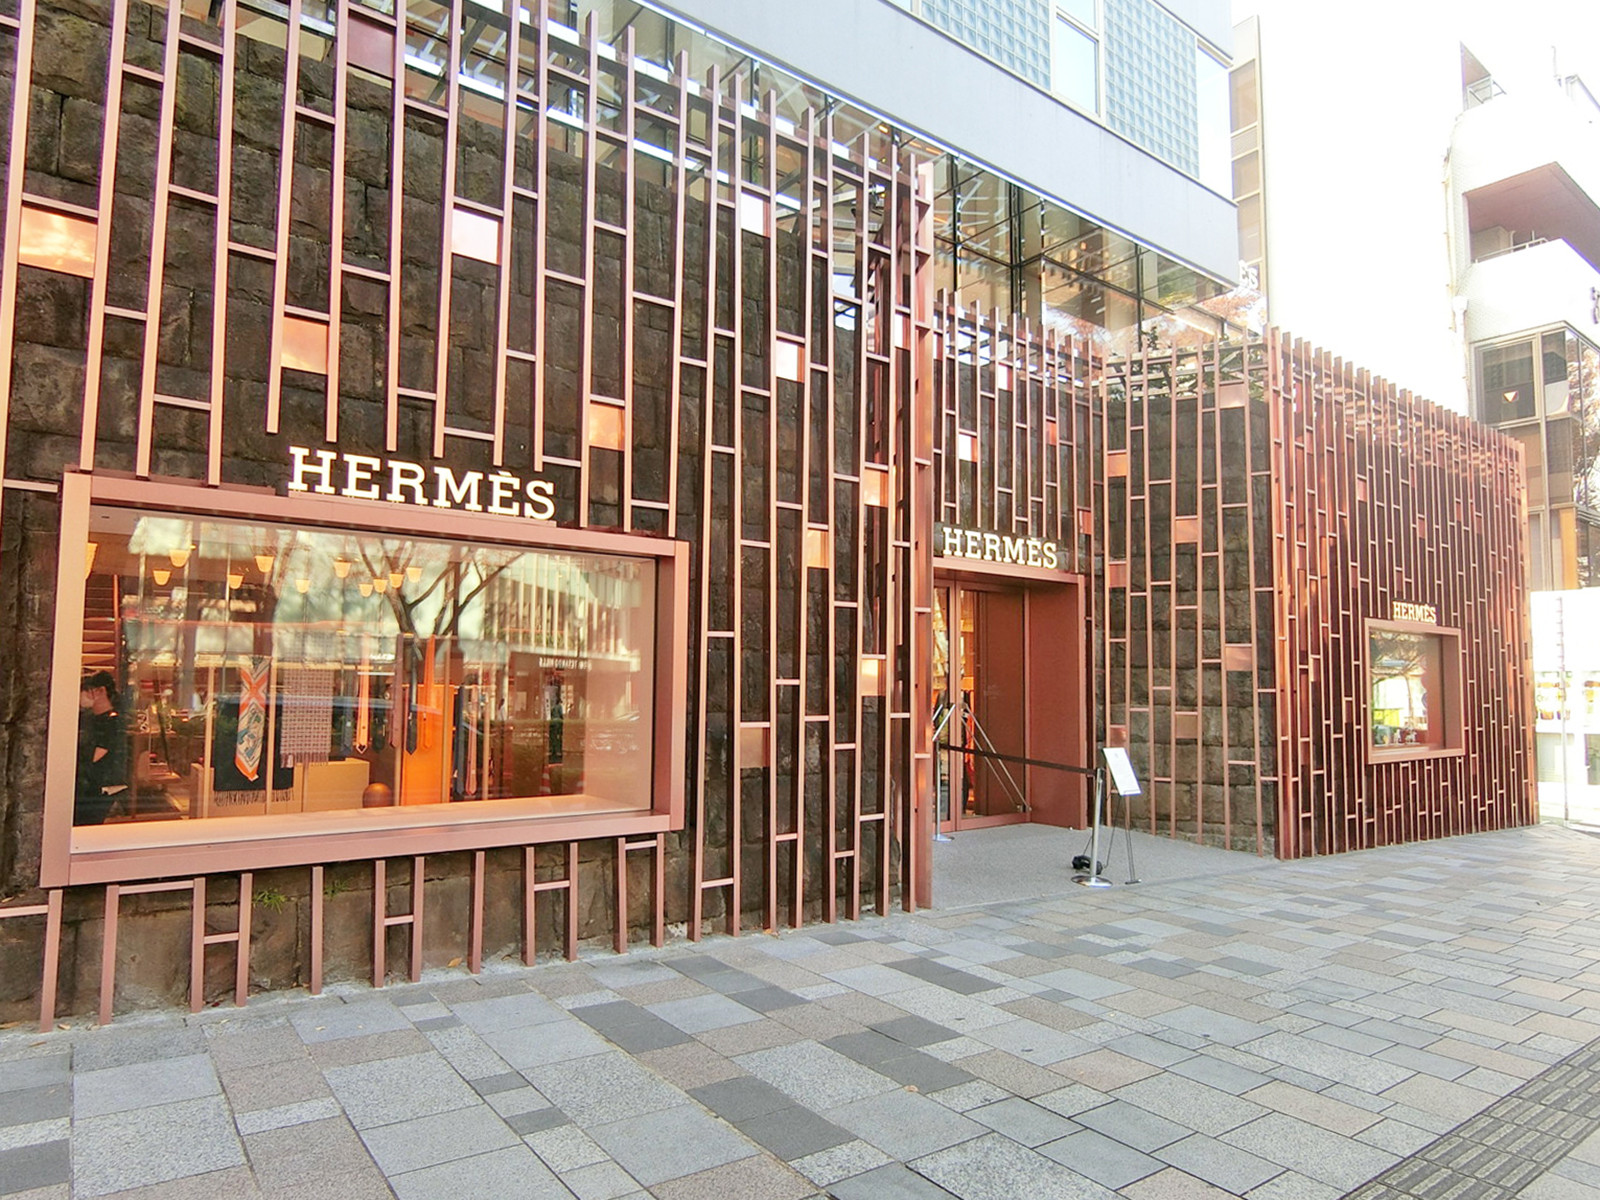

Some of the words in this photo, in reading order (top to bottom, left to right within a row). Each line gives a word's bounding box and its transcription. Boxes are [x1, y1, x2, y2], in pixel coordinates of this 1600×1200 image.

[288, 446, 556, 520] HERMÈS
[943, 526, 1058, 570] HERMÈS
[1392, 601, 1437, 624] HERMÈS
